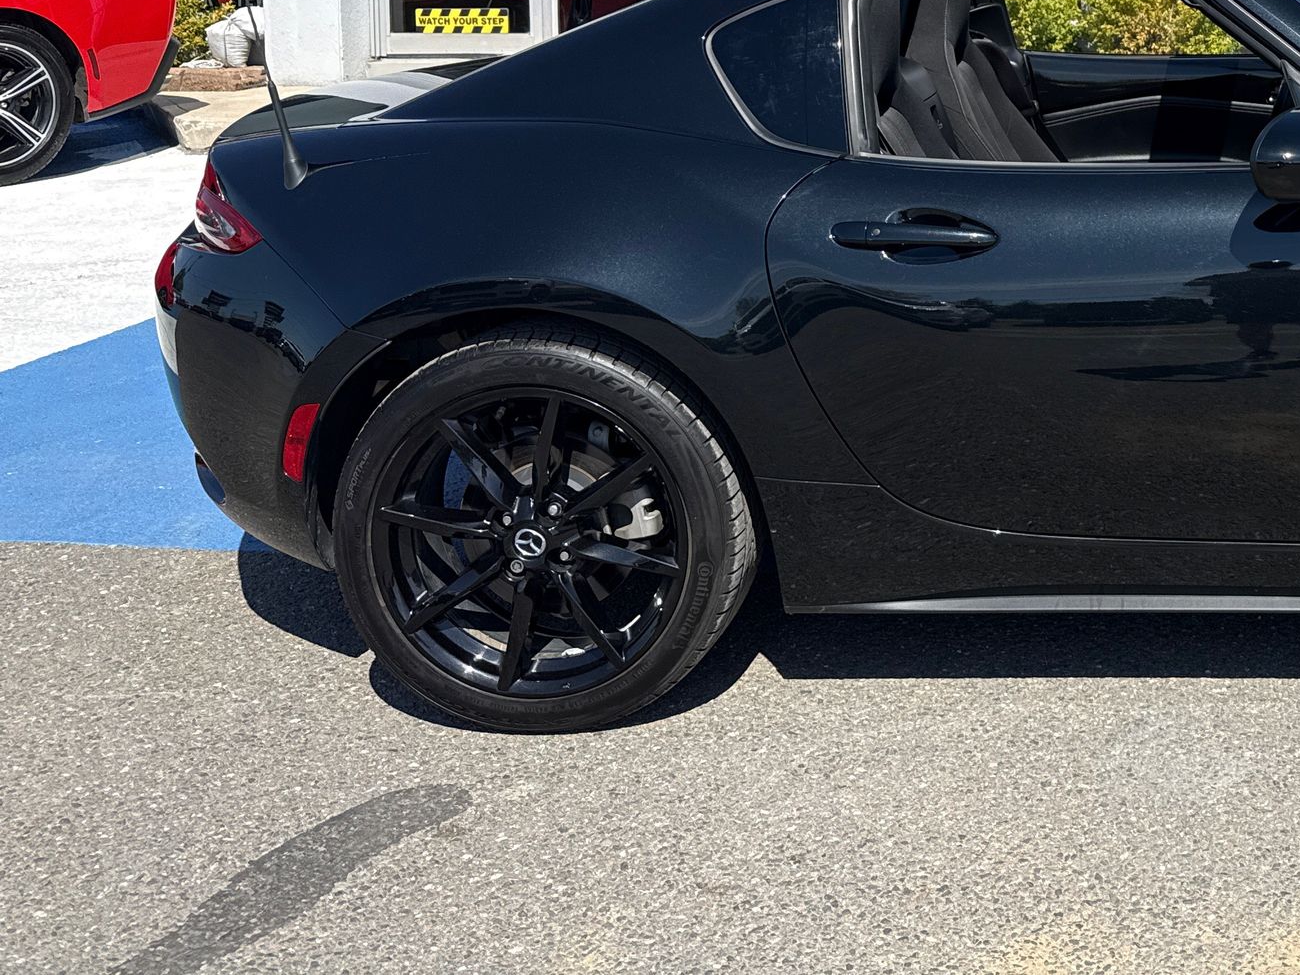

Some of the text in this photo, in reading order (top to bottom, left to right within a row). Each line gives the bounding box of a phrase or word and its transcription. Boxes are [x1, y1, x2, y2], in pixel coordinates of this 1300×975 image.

[418, 17, 504, 26] WATCH YOUR STEP
[480, 353, 686, 439] CONTINENTAL
